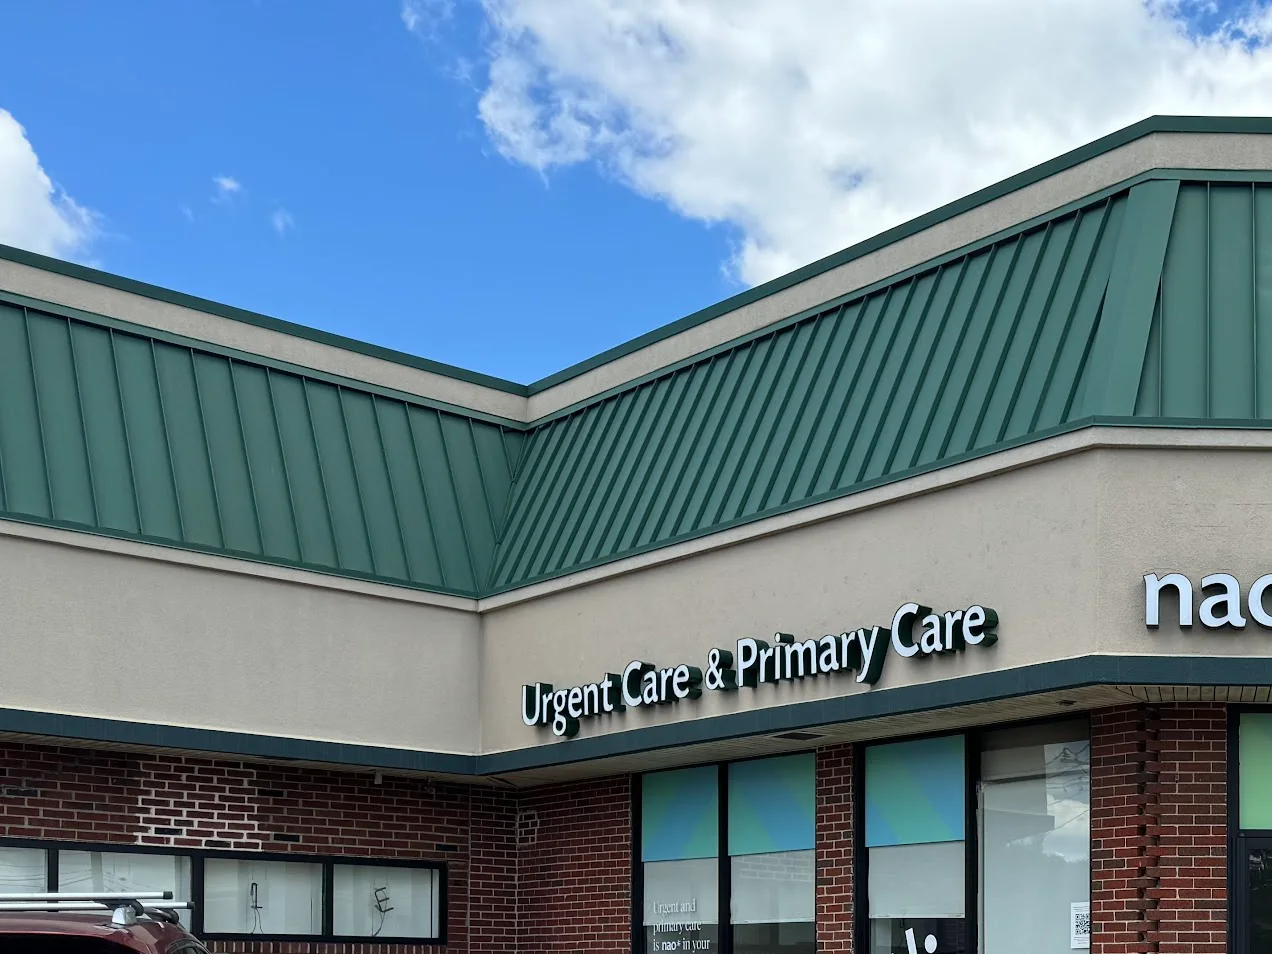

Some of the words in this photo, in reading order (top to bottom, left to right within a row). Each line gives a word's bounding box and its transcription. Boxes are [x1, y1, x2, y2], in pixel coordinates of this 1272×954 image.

[521, 672, 614, 737] Urgent
[620, 658, 690, 709] Care
[704, 647, 727, 691] &
[736, 631, 881, 685] Primary
[890, 601, 990, 659] Care
[653, 900, 679, 915] Urgent
[680, 898, 696, 912] and
[653, 938, 660, 952] is
[682, 937, 691, 950] in
[692, 939, 711, 953] your
